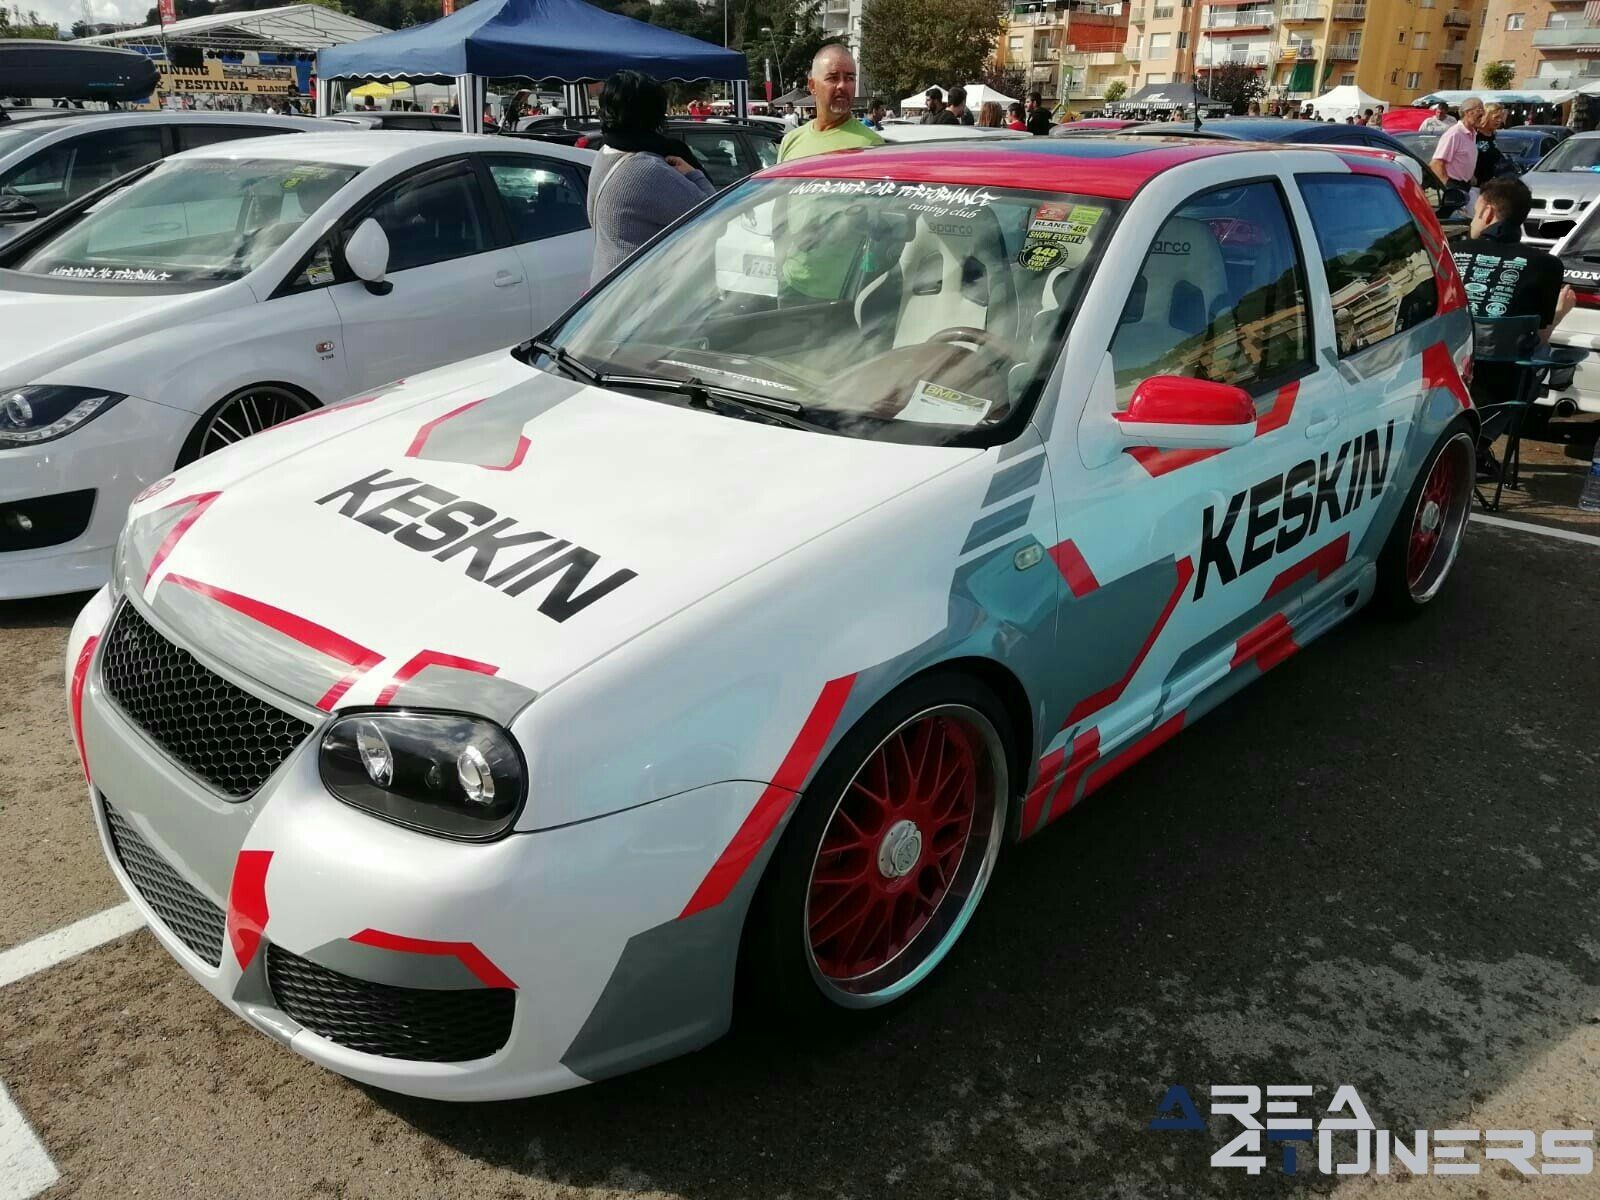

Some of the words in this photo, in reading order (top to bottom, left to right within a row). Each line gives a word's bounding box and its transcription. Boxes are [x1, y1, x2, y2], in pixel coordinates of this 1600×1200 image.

[175, 79, 248, 92] FESTIVAL
[257, 85, 288, 93] BLANE
[908, 202, 948, 217] tuning
[949, 204, 982, 219] club
[1073, 225, 1089, 233] 456
[1029, 231, 1053, 241] SHOW
[1053, 234, 1080, 243] EVENT
[1152, 241, 1191, 252] arco
[1563, 269, 1600, 281] VOLV
[1193, 418, 1394, 603] KESKIN
[314, 468, 639, 623] KESKIN
